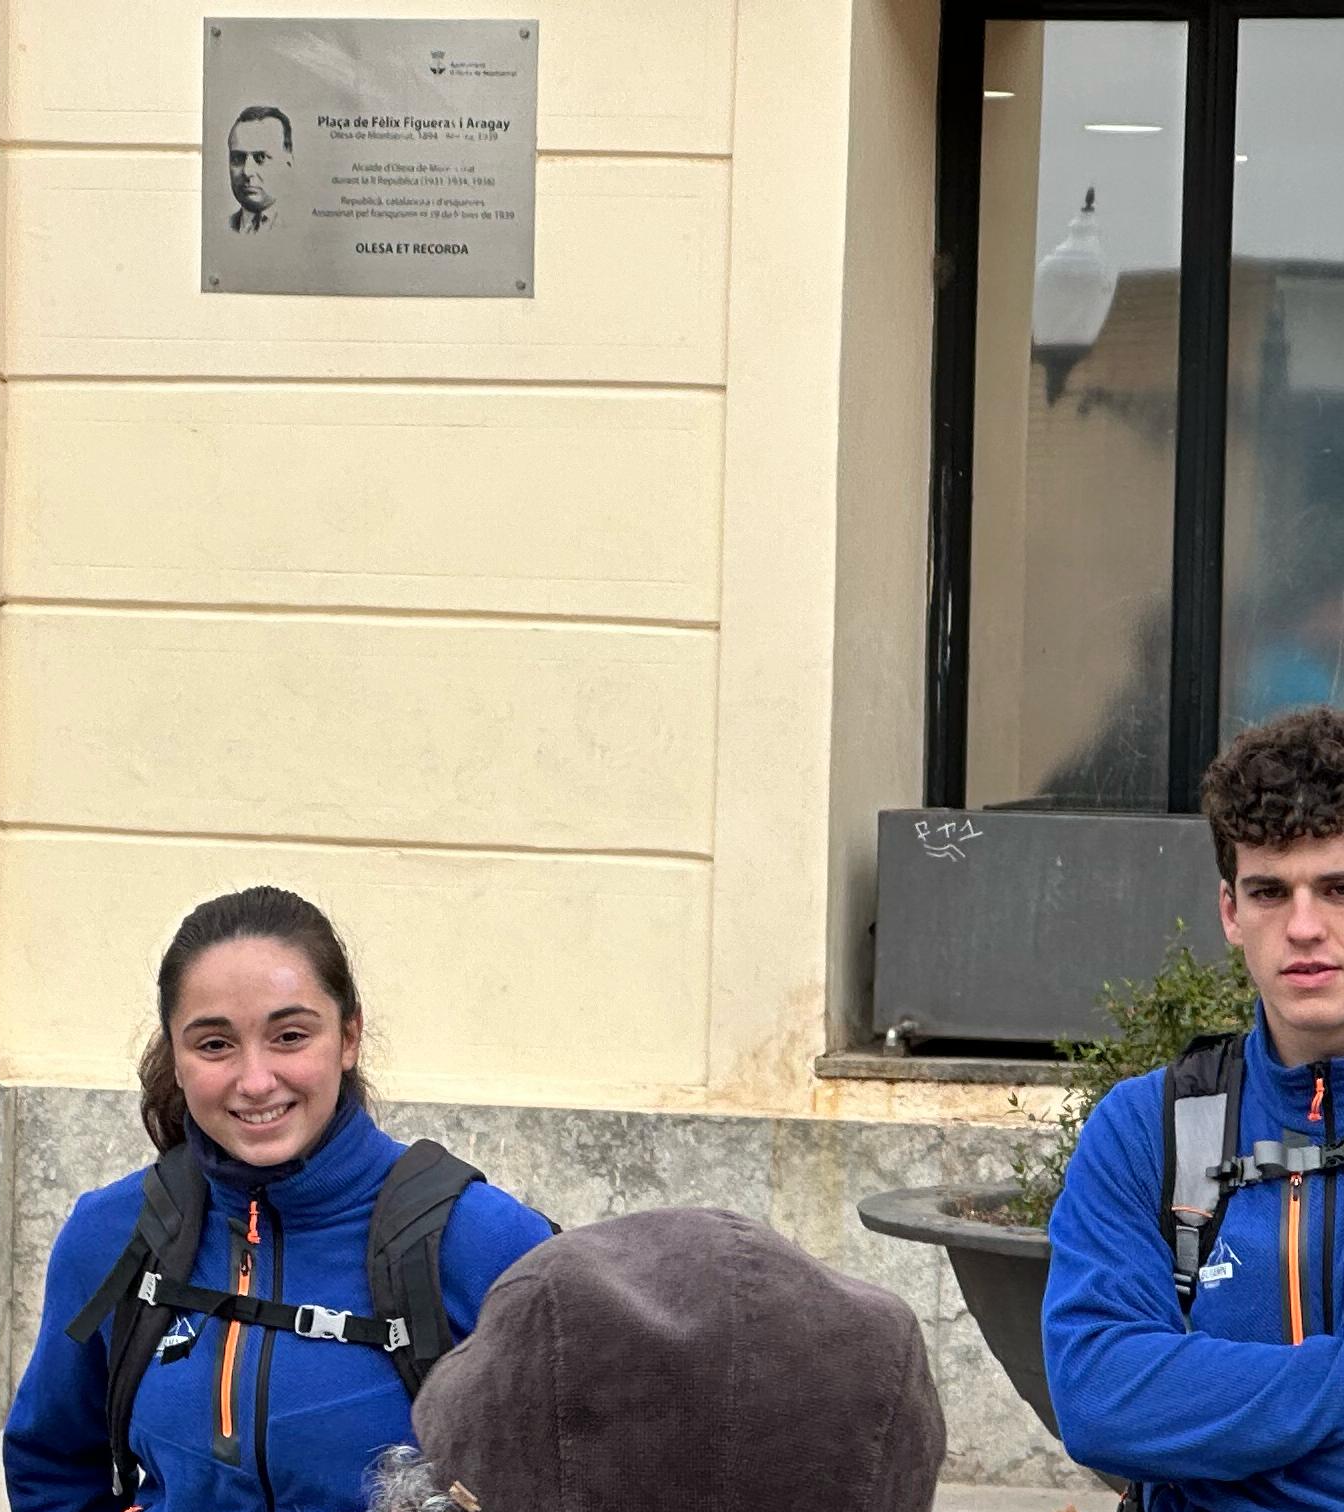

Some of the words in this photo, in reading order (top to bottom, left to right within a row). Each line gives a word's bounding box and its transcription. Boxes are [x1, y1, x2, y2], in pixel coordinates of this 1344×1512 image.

[317, 115, 351, 130] Plaça
[353, 115, 369, 128] de
[403, 116, 456, 131] Figueras
[458, 116, 464, 129] i
[466, 117, 511, 132] Aragay
[355, 242, 394, 254] OLESA
[396, 243, 411, 255] ET
[413, 243, 469, 255] RECORDA
